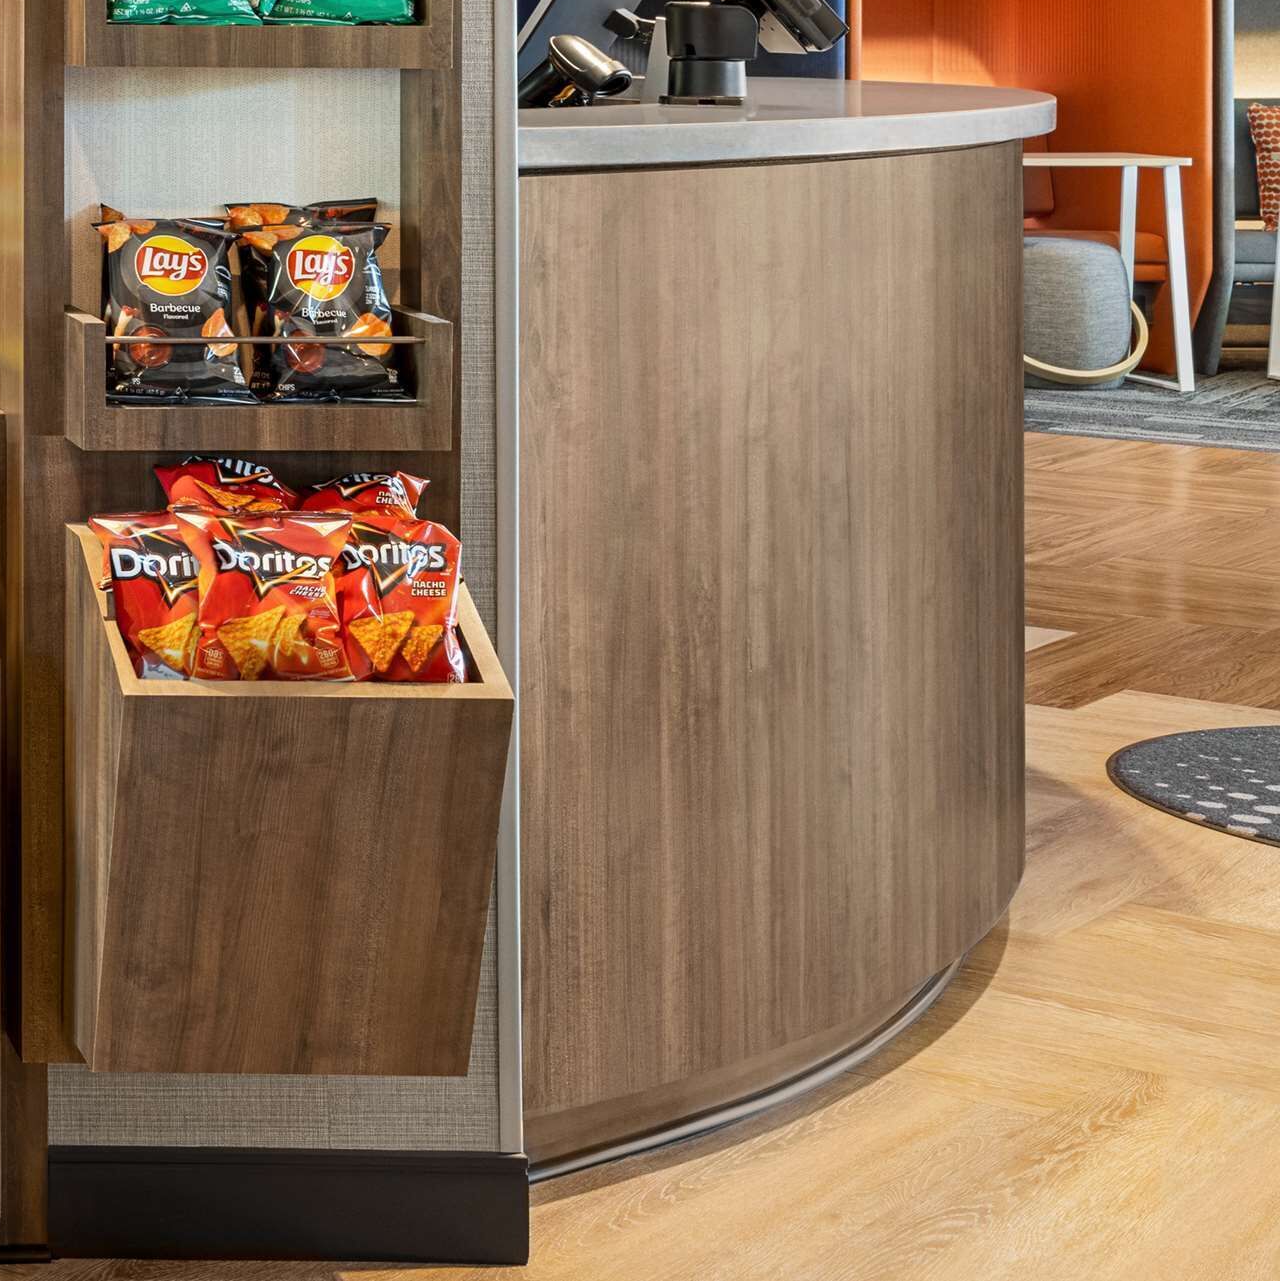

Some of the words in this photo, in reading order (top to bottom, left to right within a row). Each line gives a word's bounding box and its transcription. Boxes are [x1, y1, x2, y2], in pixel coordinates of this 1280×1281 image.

[140, 246, 203, 280] Lay's
[295, 245, 350, 283] Lay's
[149, 303, 201, 314] Barbecue
[301, 306, 348, 319] Barbecue
[111, 548, 199, 580] Dorit
[214, 540, 332, 577] Doritos
[411, 588, 447, 597] CHEESE
[412, 580, 446, 589] NACHO
